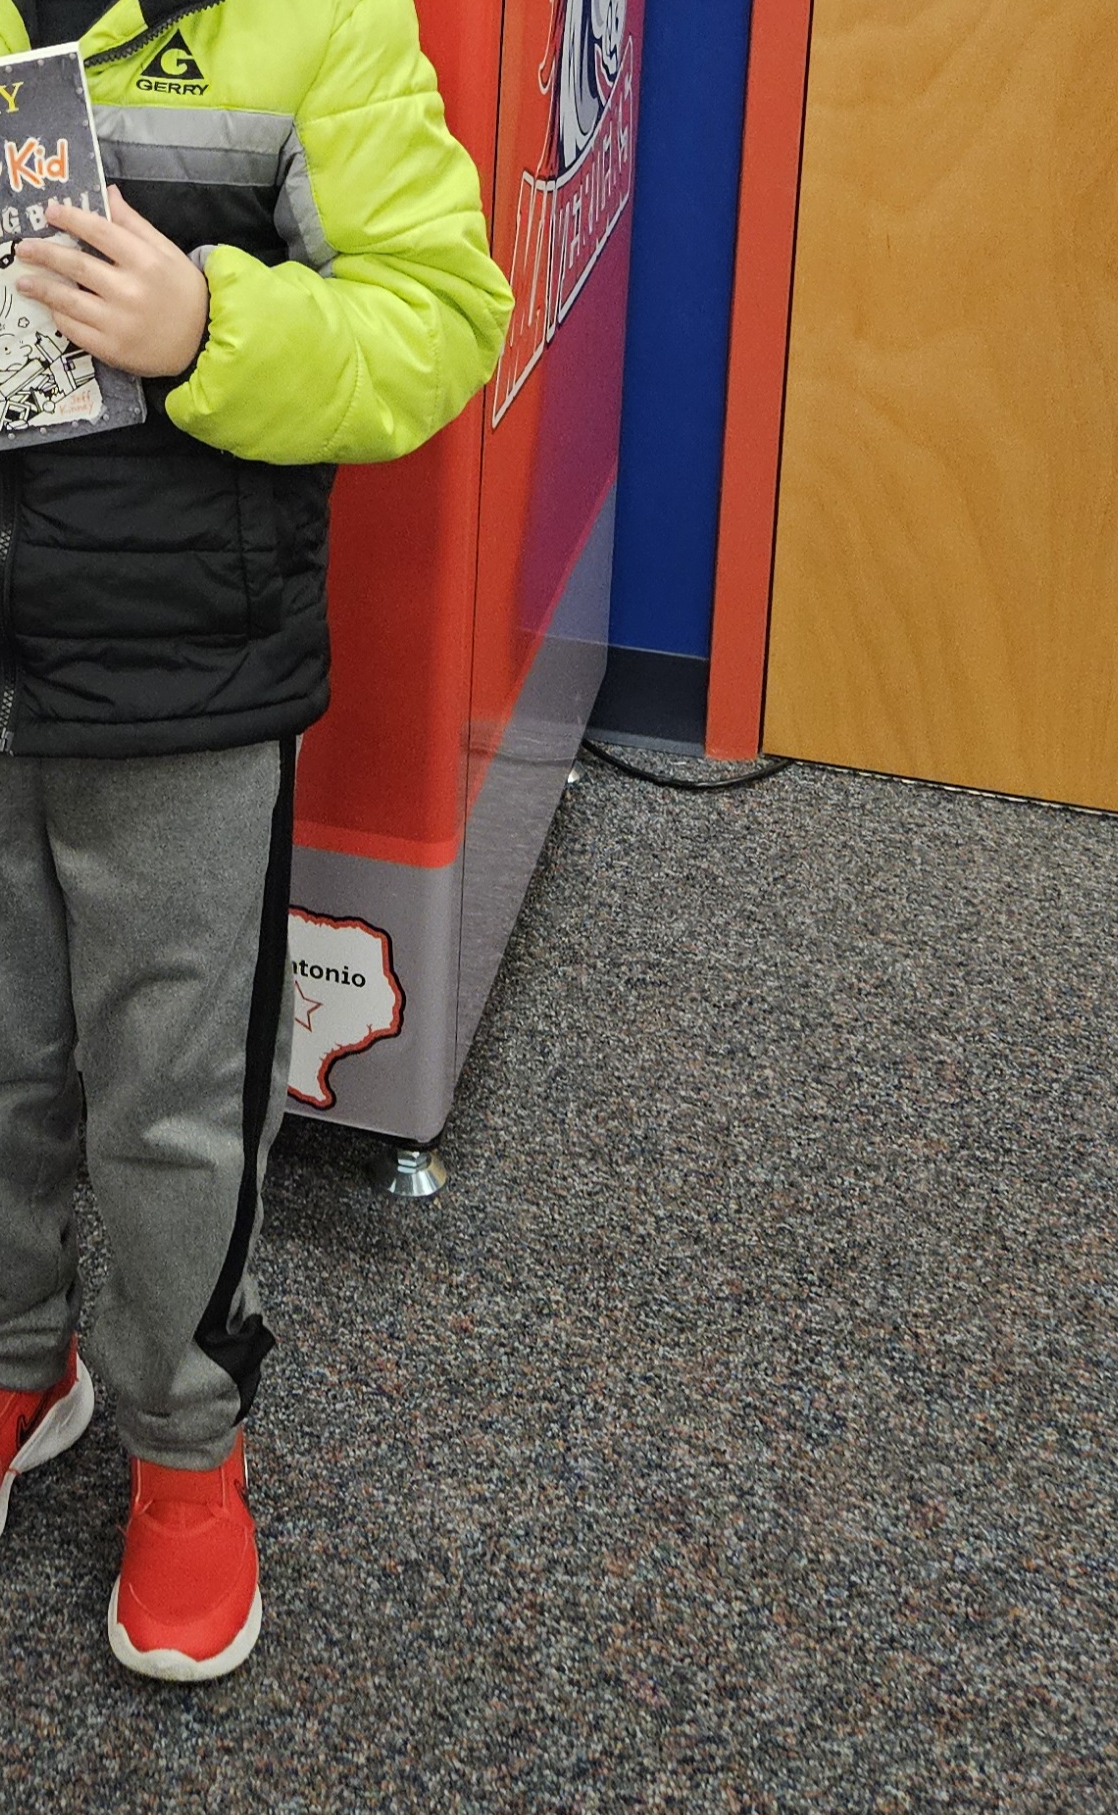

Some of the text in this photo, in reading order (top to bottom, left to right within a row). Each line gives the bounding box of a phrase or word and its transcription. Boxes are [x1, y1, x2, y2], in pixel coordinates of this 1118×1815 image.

[136, 78, 210, 96] GERRY
[4, 137, 69, 192] Kid
[27, 190, 98, 232] BL
[292, 959, 366, 988] tonio
